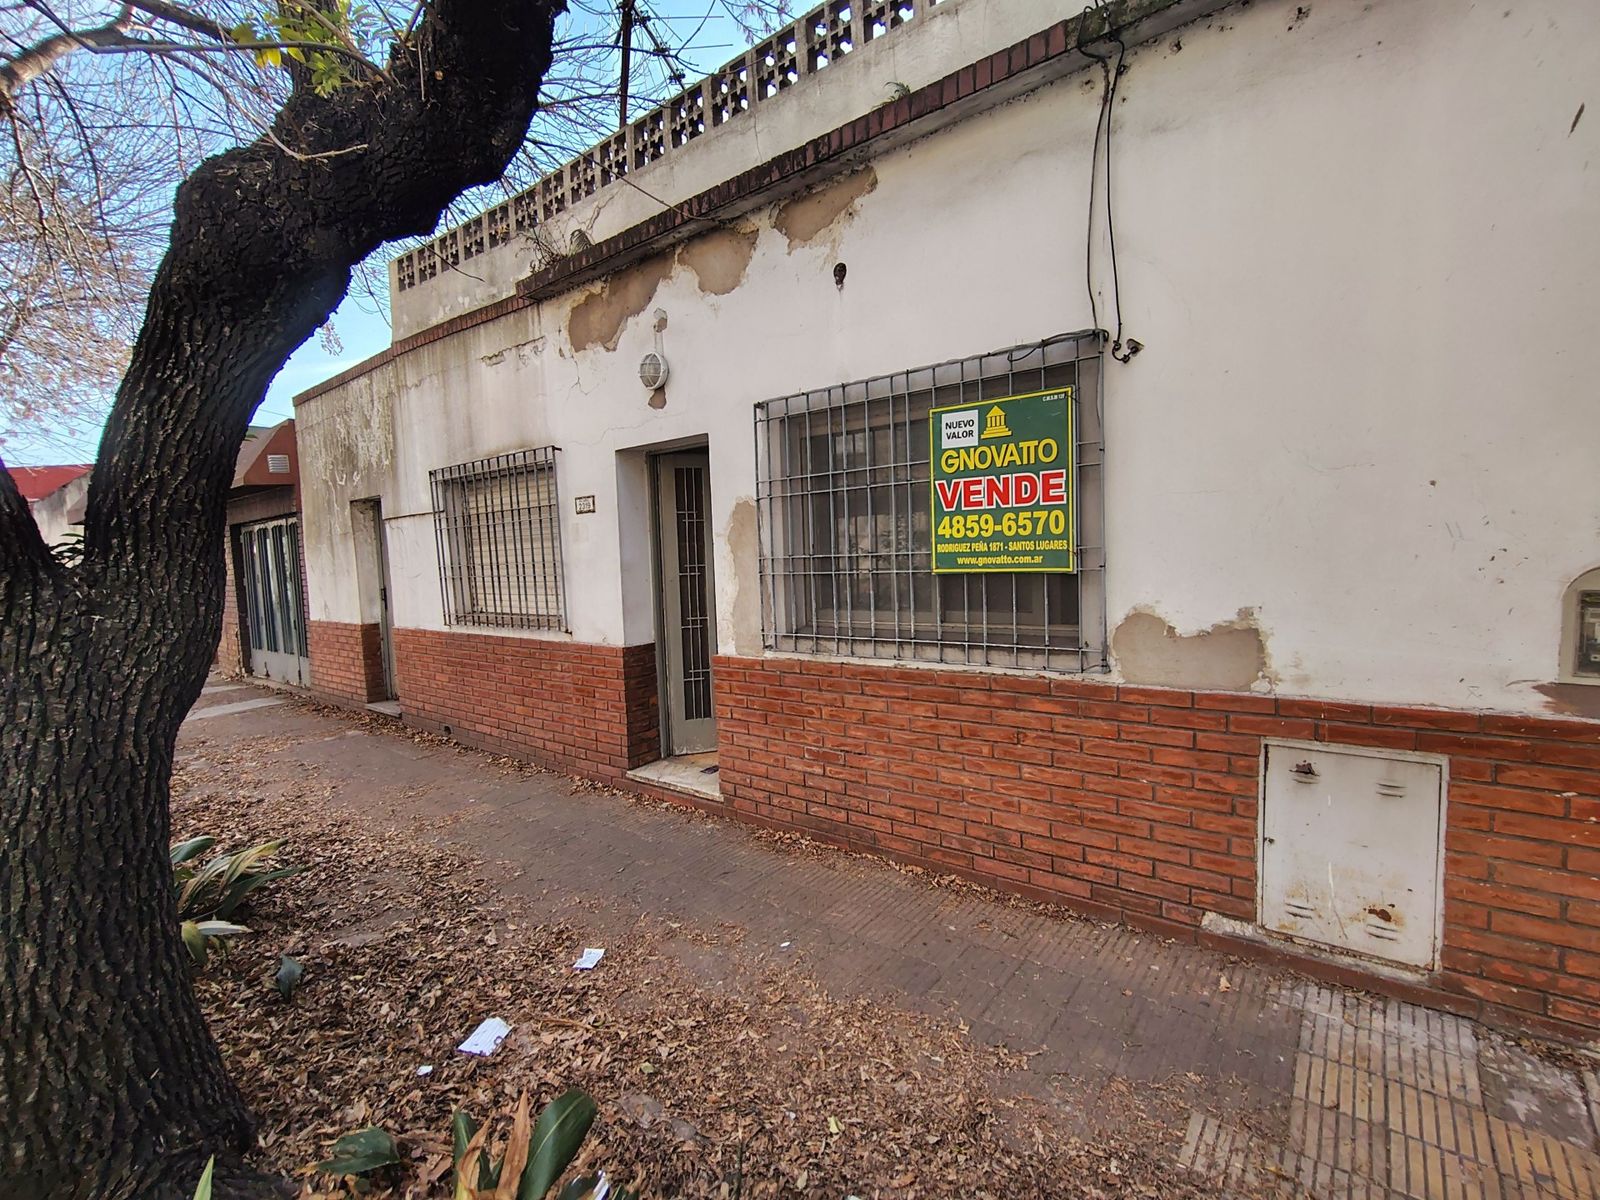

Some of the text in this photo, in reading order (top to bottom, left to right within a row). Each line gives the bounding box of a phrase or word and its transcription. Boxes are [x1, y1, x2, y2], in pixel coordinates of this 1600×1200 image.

[945, 419, 975, 430] NUEVO
[946, 430, 974, 440] VALOR
[941, 438, 1058, 474] GNOVATTO
[935, 469, 1067, 512] VENDE
[937, 510, 1066, 539] 4859-6570
[937, 542, 971, 553] RODRIGUEZ
[971, 540, 988, 552] PEÑA
[989, 542, 1004, 552] 1871
[1008, 541, 1035, 551] SANTOS
[1035, 540, 1068, 550] LUGARES
[957, 555, 1043, 566] www.gnovatto.com.ar
